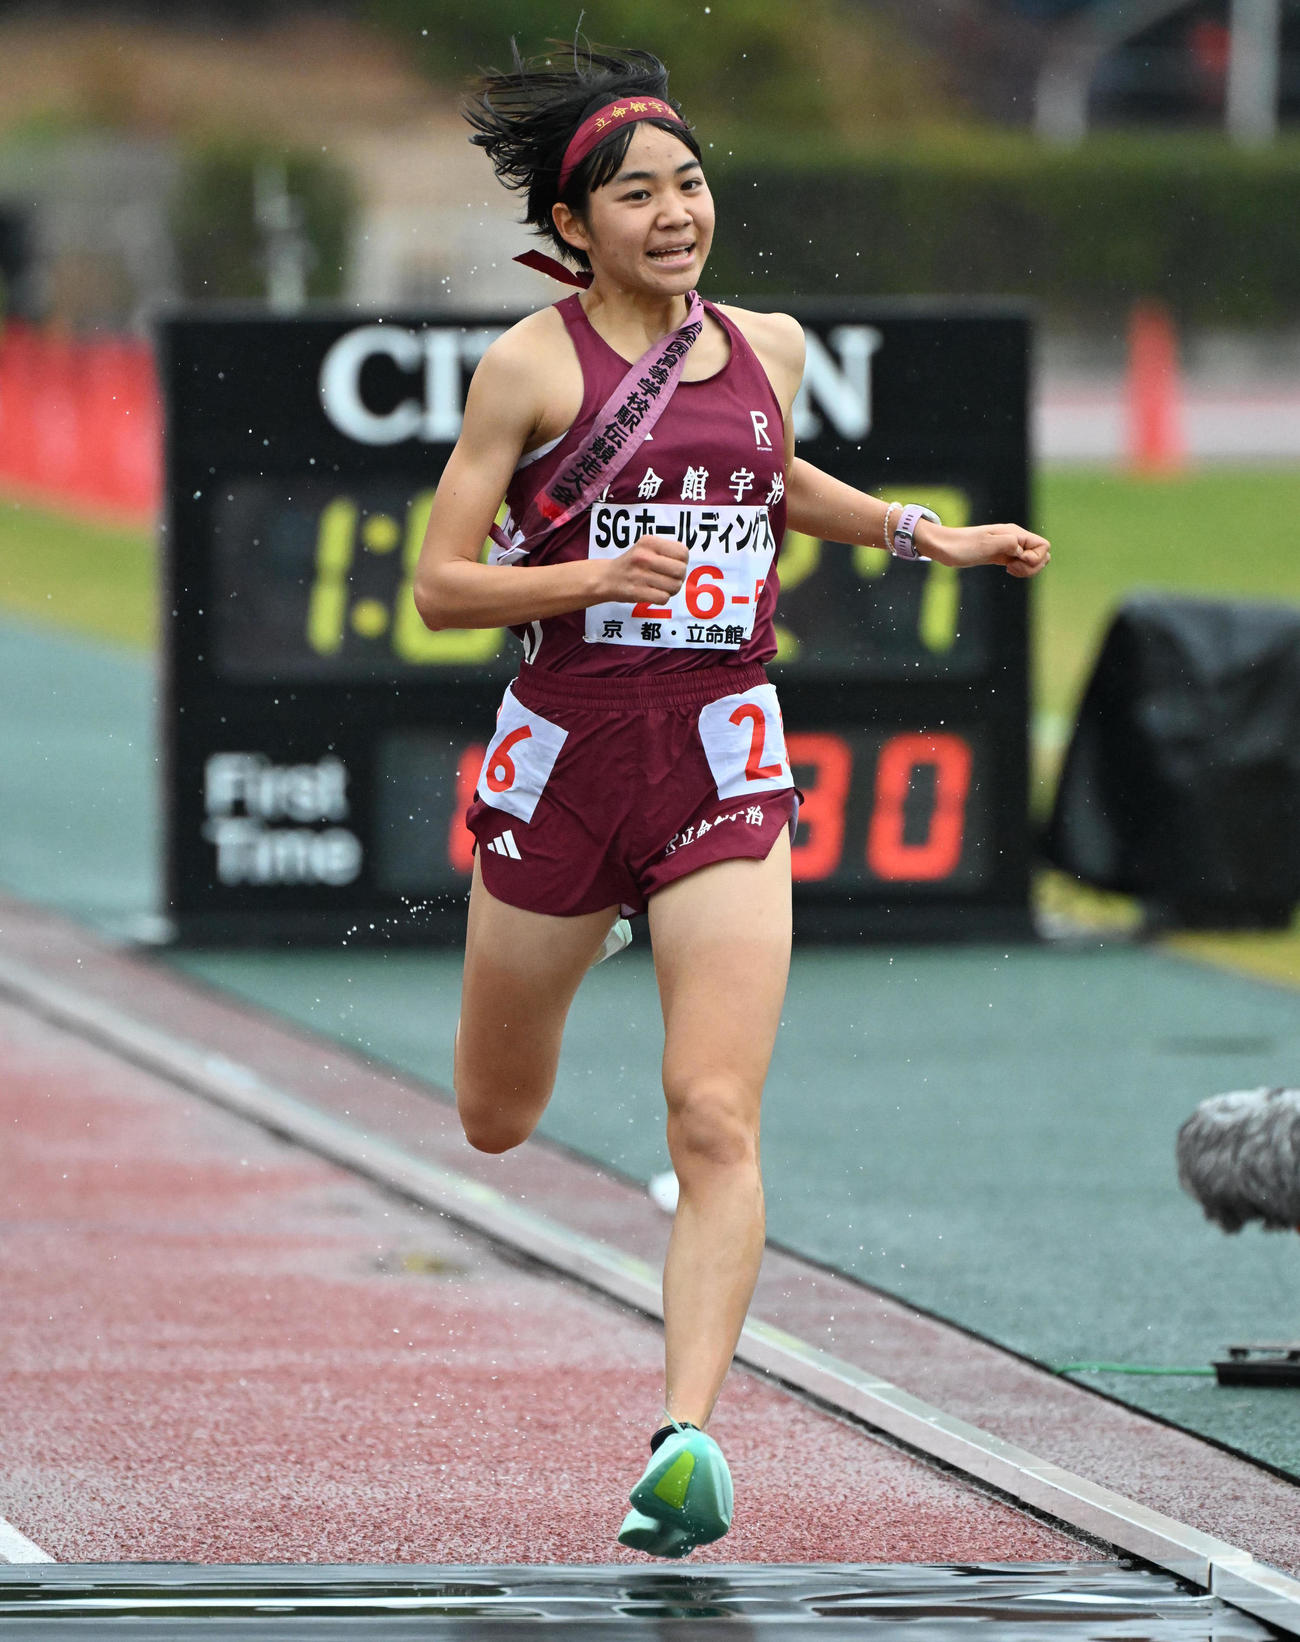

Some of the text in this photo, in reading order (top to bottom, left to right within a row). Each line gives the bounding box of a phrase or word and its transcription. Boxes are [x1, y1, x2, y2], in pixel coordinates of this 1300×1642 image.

[750, 410, 772, 446] R
[598, 466, 785, 505] 命館宇治
[486, 702, 533, 793] 6
[728, 703, 794, 783] 2
[204, 752, 347, 822] First
